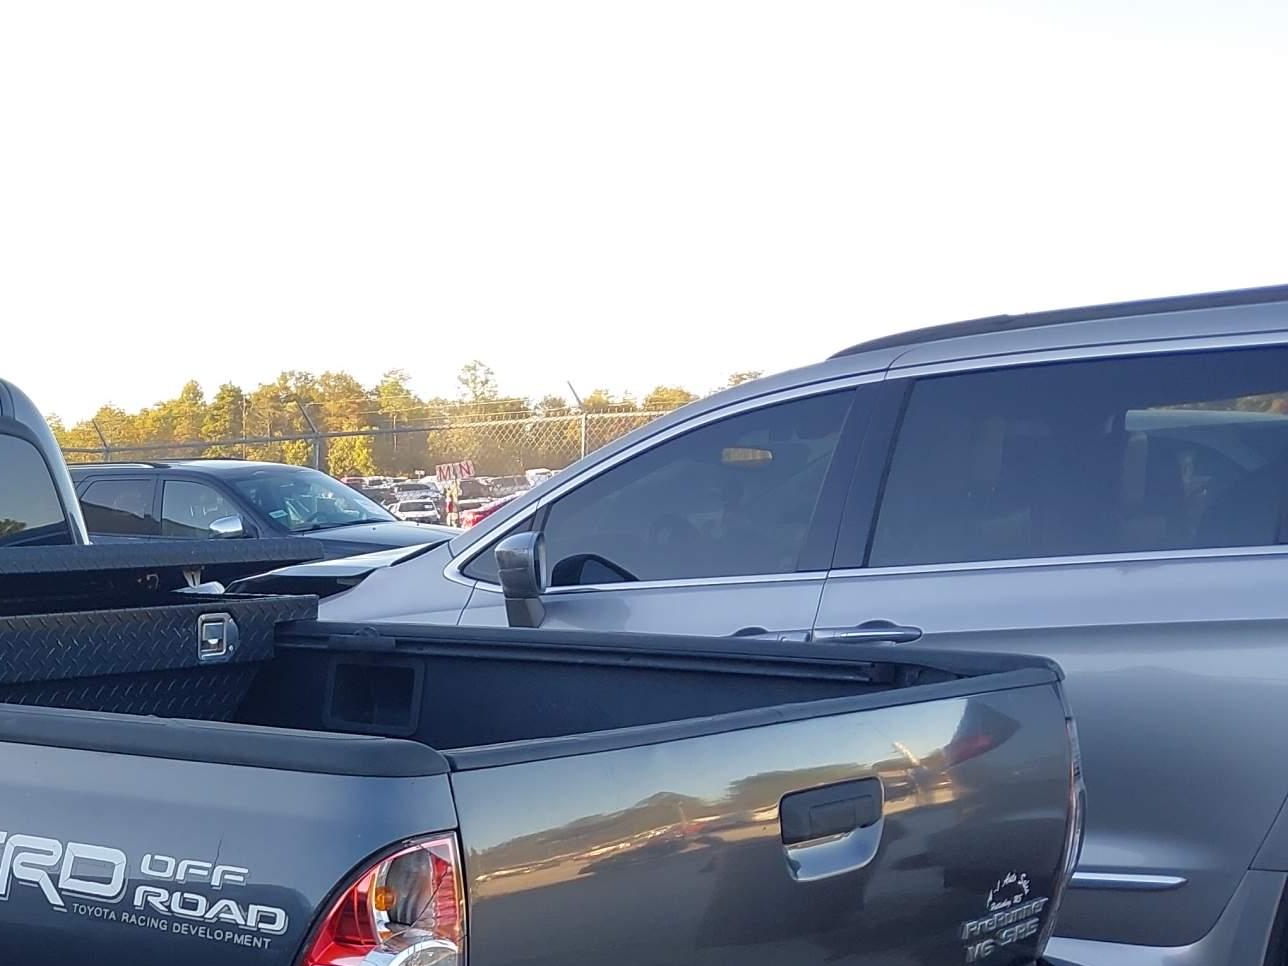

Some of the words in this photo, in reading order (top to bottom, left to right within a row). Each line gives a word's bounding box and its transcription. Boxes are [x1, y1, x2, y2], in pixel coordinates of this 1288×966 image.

[140, 853, 249, 888] OFF
[72, 902, 116, 921] TOYOTA
[120, 914, 168, 932] RACING
[172, 923, 272, 950] DEVELOPMENT
[133, 885, 289, 933] ROAD
